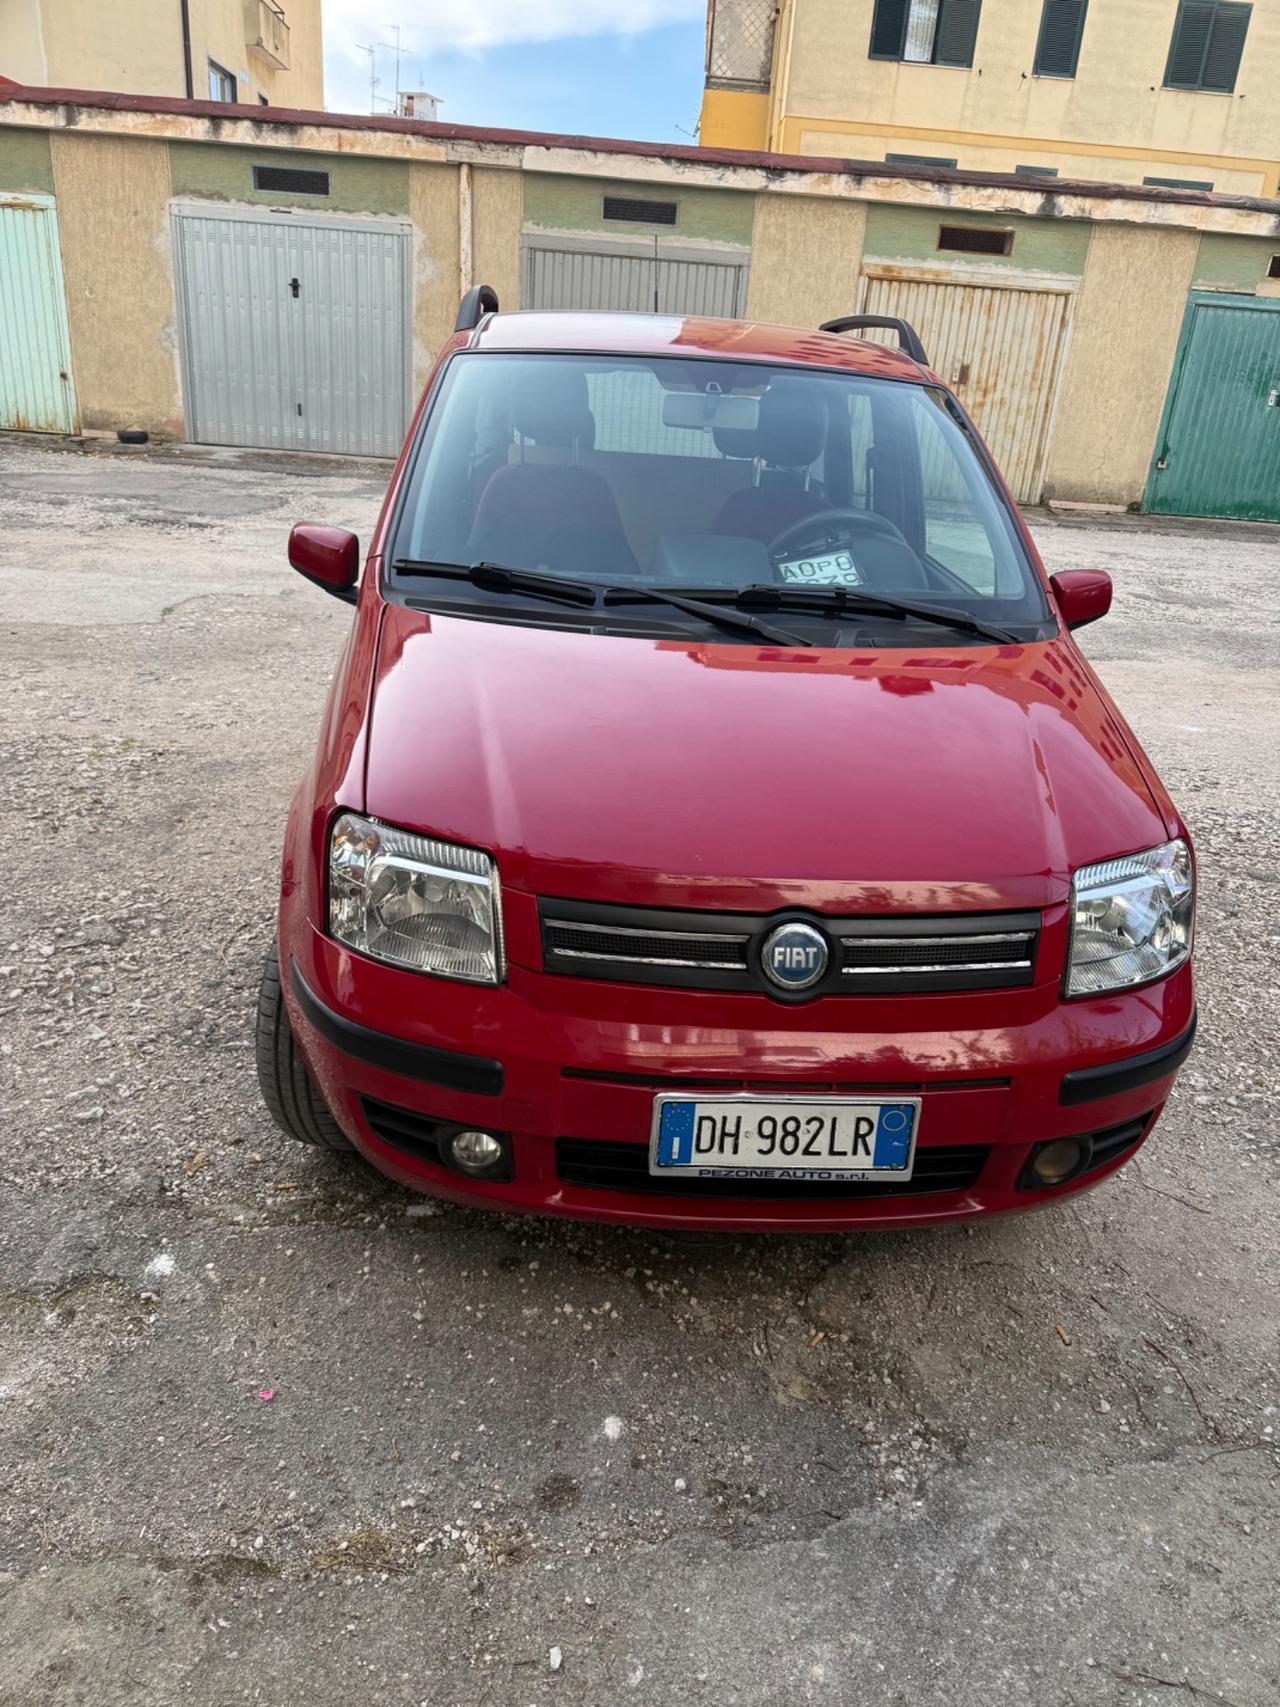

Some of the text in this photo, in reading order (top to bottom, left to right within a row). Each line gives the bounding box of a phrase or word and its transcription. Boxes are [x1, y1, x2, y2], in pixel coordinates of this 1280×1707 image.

[773, 947, 818, 969] FIAT
[698, 1168, 870, 1181] PEZONE AUTO s.r.l.
